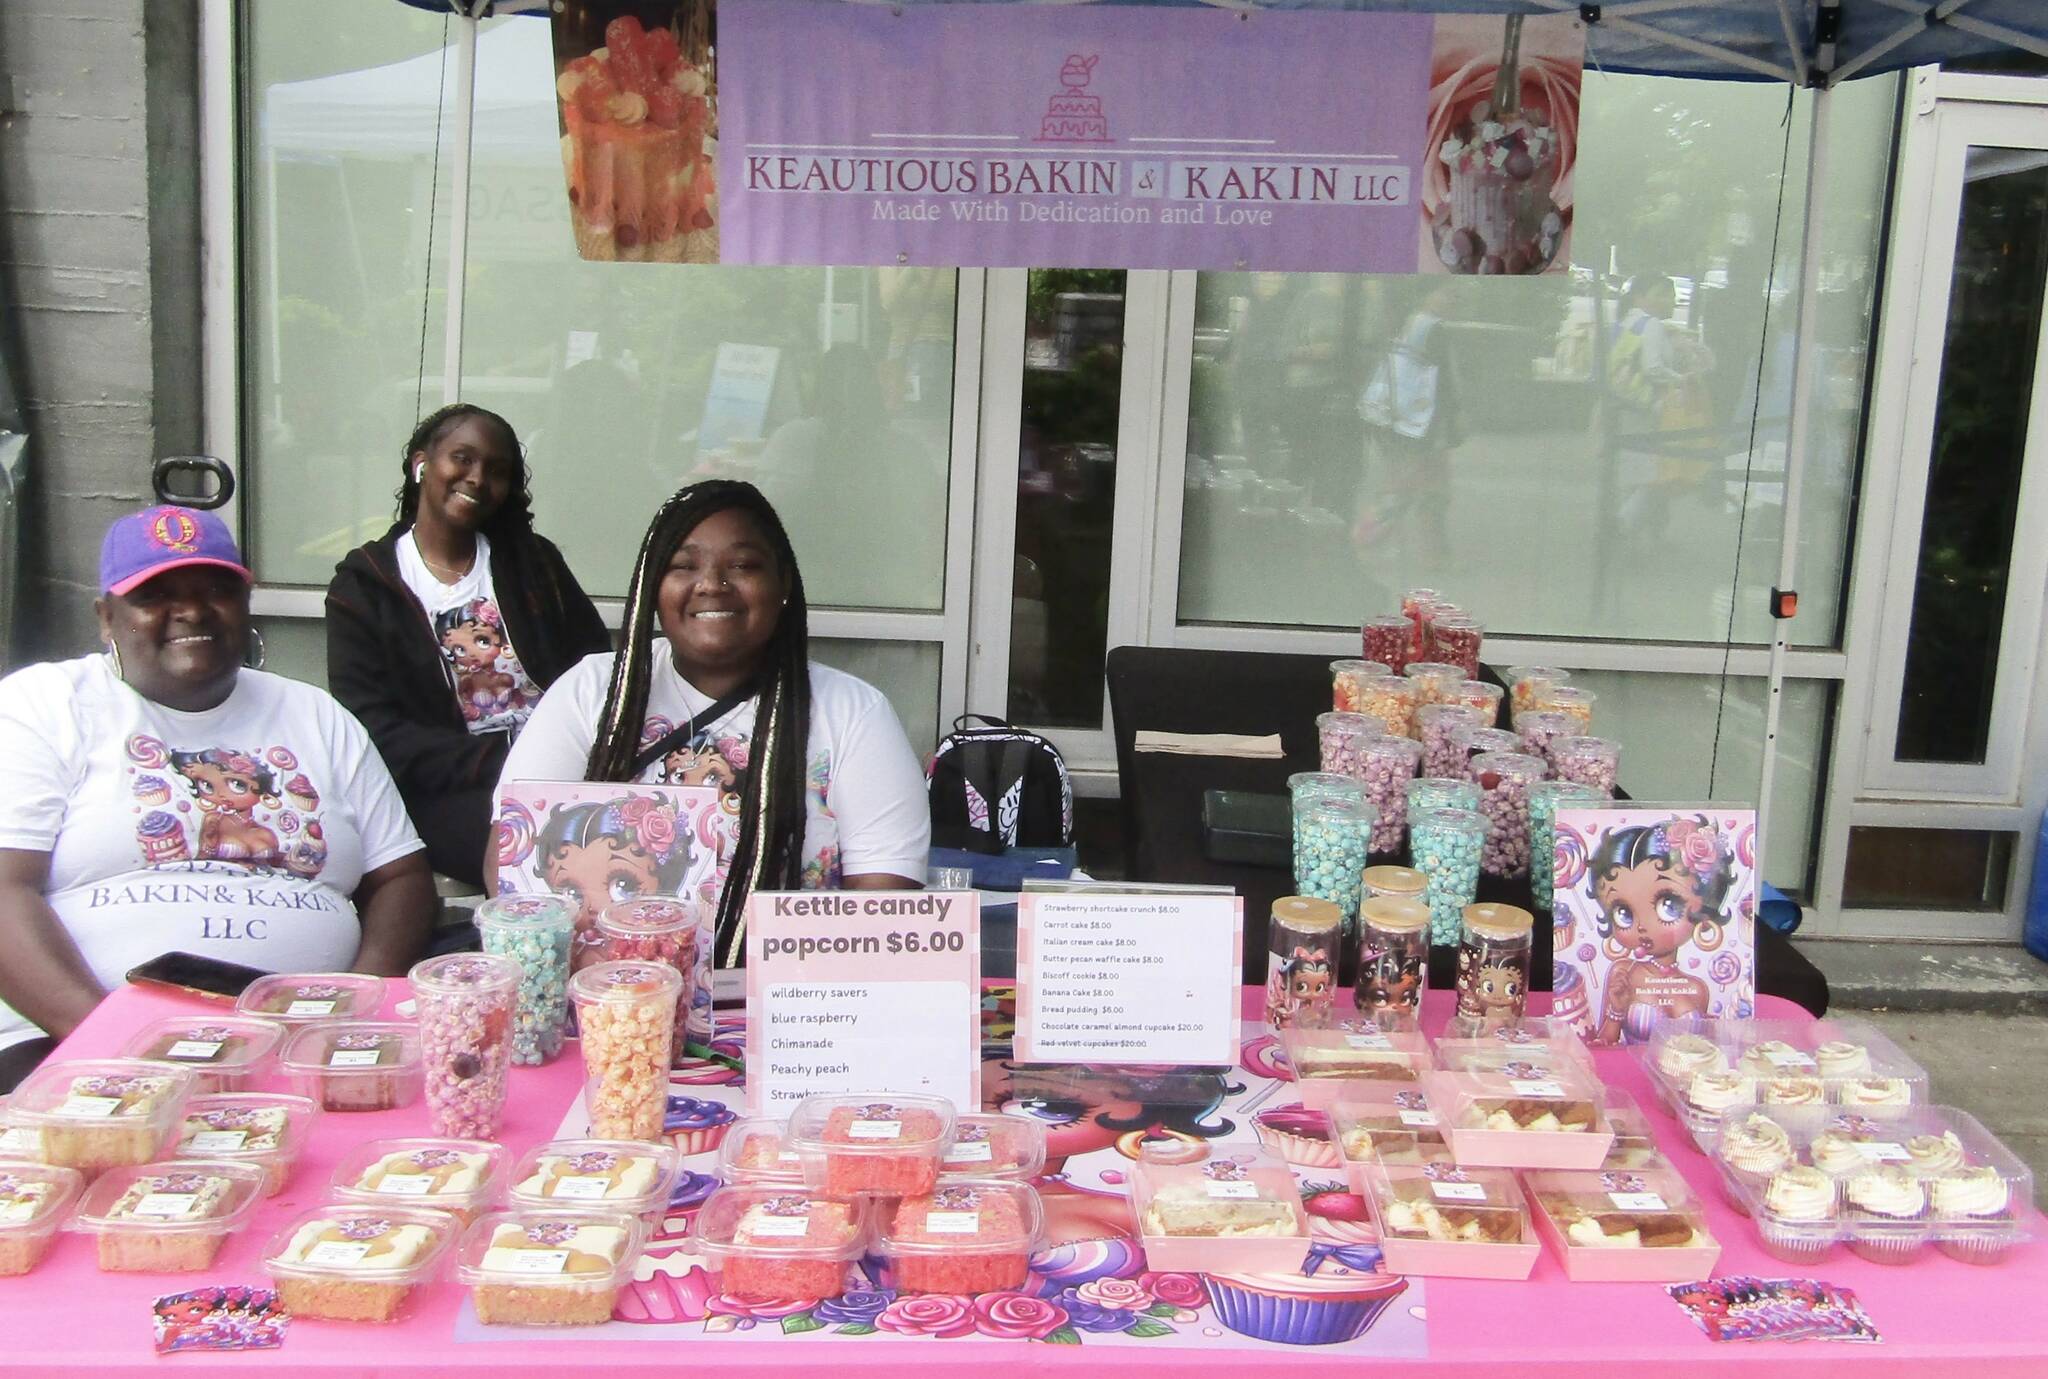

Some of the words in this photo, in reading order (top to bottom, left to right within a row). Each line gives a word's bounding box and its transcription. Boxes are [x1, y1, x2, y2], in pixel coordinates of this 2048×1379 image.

[748, 156, 978, 193] KEAUTIOUS
[987, 160, 1117, 195] BAKIN
[1138, 168, 1155, 190] &
[1184, 165, 1340, 201] KAKIN
[1353, 174, 1401, 202] LLC
[872, 200, 941, 222] Made
[950, 200, 1010, 223] With
[1019, 201, 1150, 225] Dedication
[1160, 204, 1205, 225] and
[1213, 205, 1273, 226] Love
[246, 888, 341, 914] KAKIN
[774, 895, 858, 917] Kettle
[863, 894, 953, 922] candy
[1043, 903, 1088, 914] Strawberry
[1090, 904, 1128, 914] shortcake
[1130, 905, 1156, 914] crunch
[201, 916, 268, 940] LLC
[1043, 921, 1069, 929] Carrot
[1070, 921, 1088, 929] cake
[1090, 921, 1112, 930] $8.00
[763, 936, 881, 961] popcorn
[886, 930, 965, 955] $6.00
[1043, 938, 1068, 946] Italian
[1070, 938, 1094, 947] cream
[1096, 938, 1113, 947] cake
[1115, 938, 1137, 947] $8.00
[1042, 954, 1068, 963] Butter
[1070, 955, 1094, 965] pecan
[1095, 954, 1121, 964] waffle
[1123, 955, 1140, 964] cake
[1142, 955, 1164, 965] $8.00
[1042, 971, 1070, 980] Biscoff
[1072, 971, 1096, 980] cookie
[1098, 971, 1120, 981] $8.00
[771, 987, 828, 1001] wildberry
[830, 987, 869, 999] savers
[1041, 988, 1070, 997] Banana
[1072, 988, 1090, 997] Cake
[1092, 988, 1114, 998] $8.00
[1658, 997, 1675, 1006] LLC
[1041, 1005, 1065, 1014] Bread
[1066, 1005, 1098, 1016] pudding
[1101, 1005, 1124, 1015] $6.00
[771, 1012, 797, 1024] blue
[800, 1012, 858, 1026] raspberry
[1041, 1022, 1080, 1031] Chocolate
[1081, 1022, 1113, 1031] caramel
[1114, 1022, 1142, 1032] almond
[1144, 1023, 1175, 1033] cupcake
[1177, 1023, 1204, 1033] $20.00
[770, 1038, 834, 1049] Chimanade
[1040, 1039, 1055, 1048] Red
[1057, 1039, 1082, 1048] velvet
[1083, 1040, 1119, 1049] cupcakes
[771, 1063, 812, 1077] Peachy
[815, 1062, 850, 1077] peach
